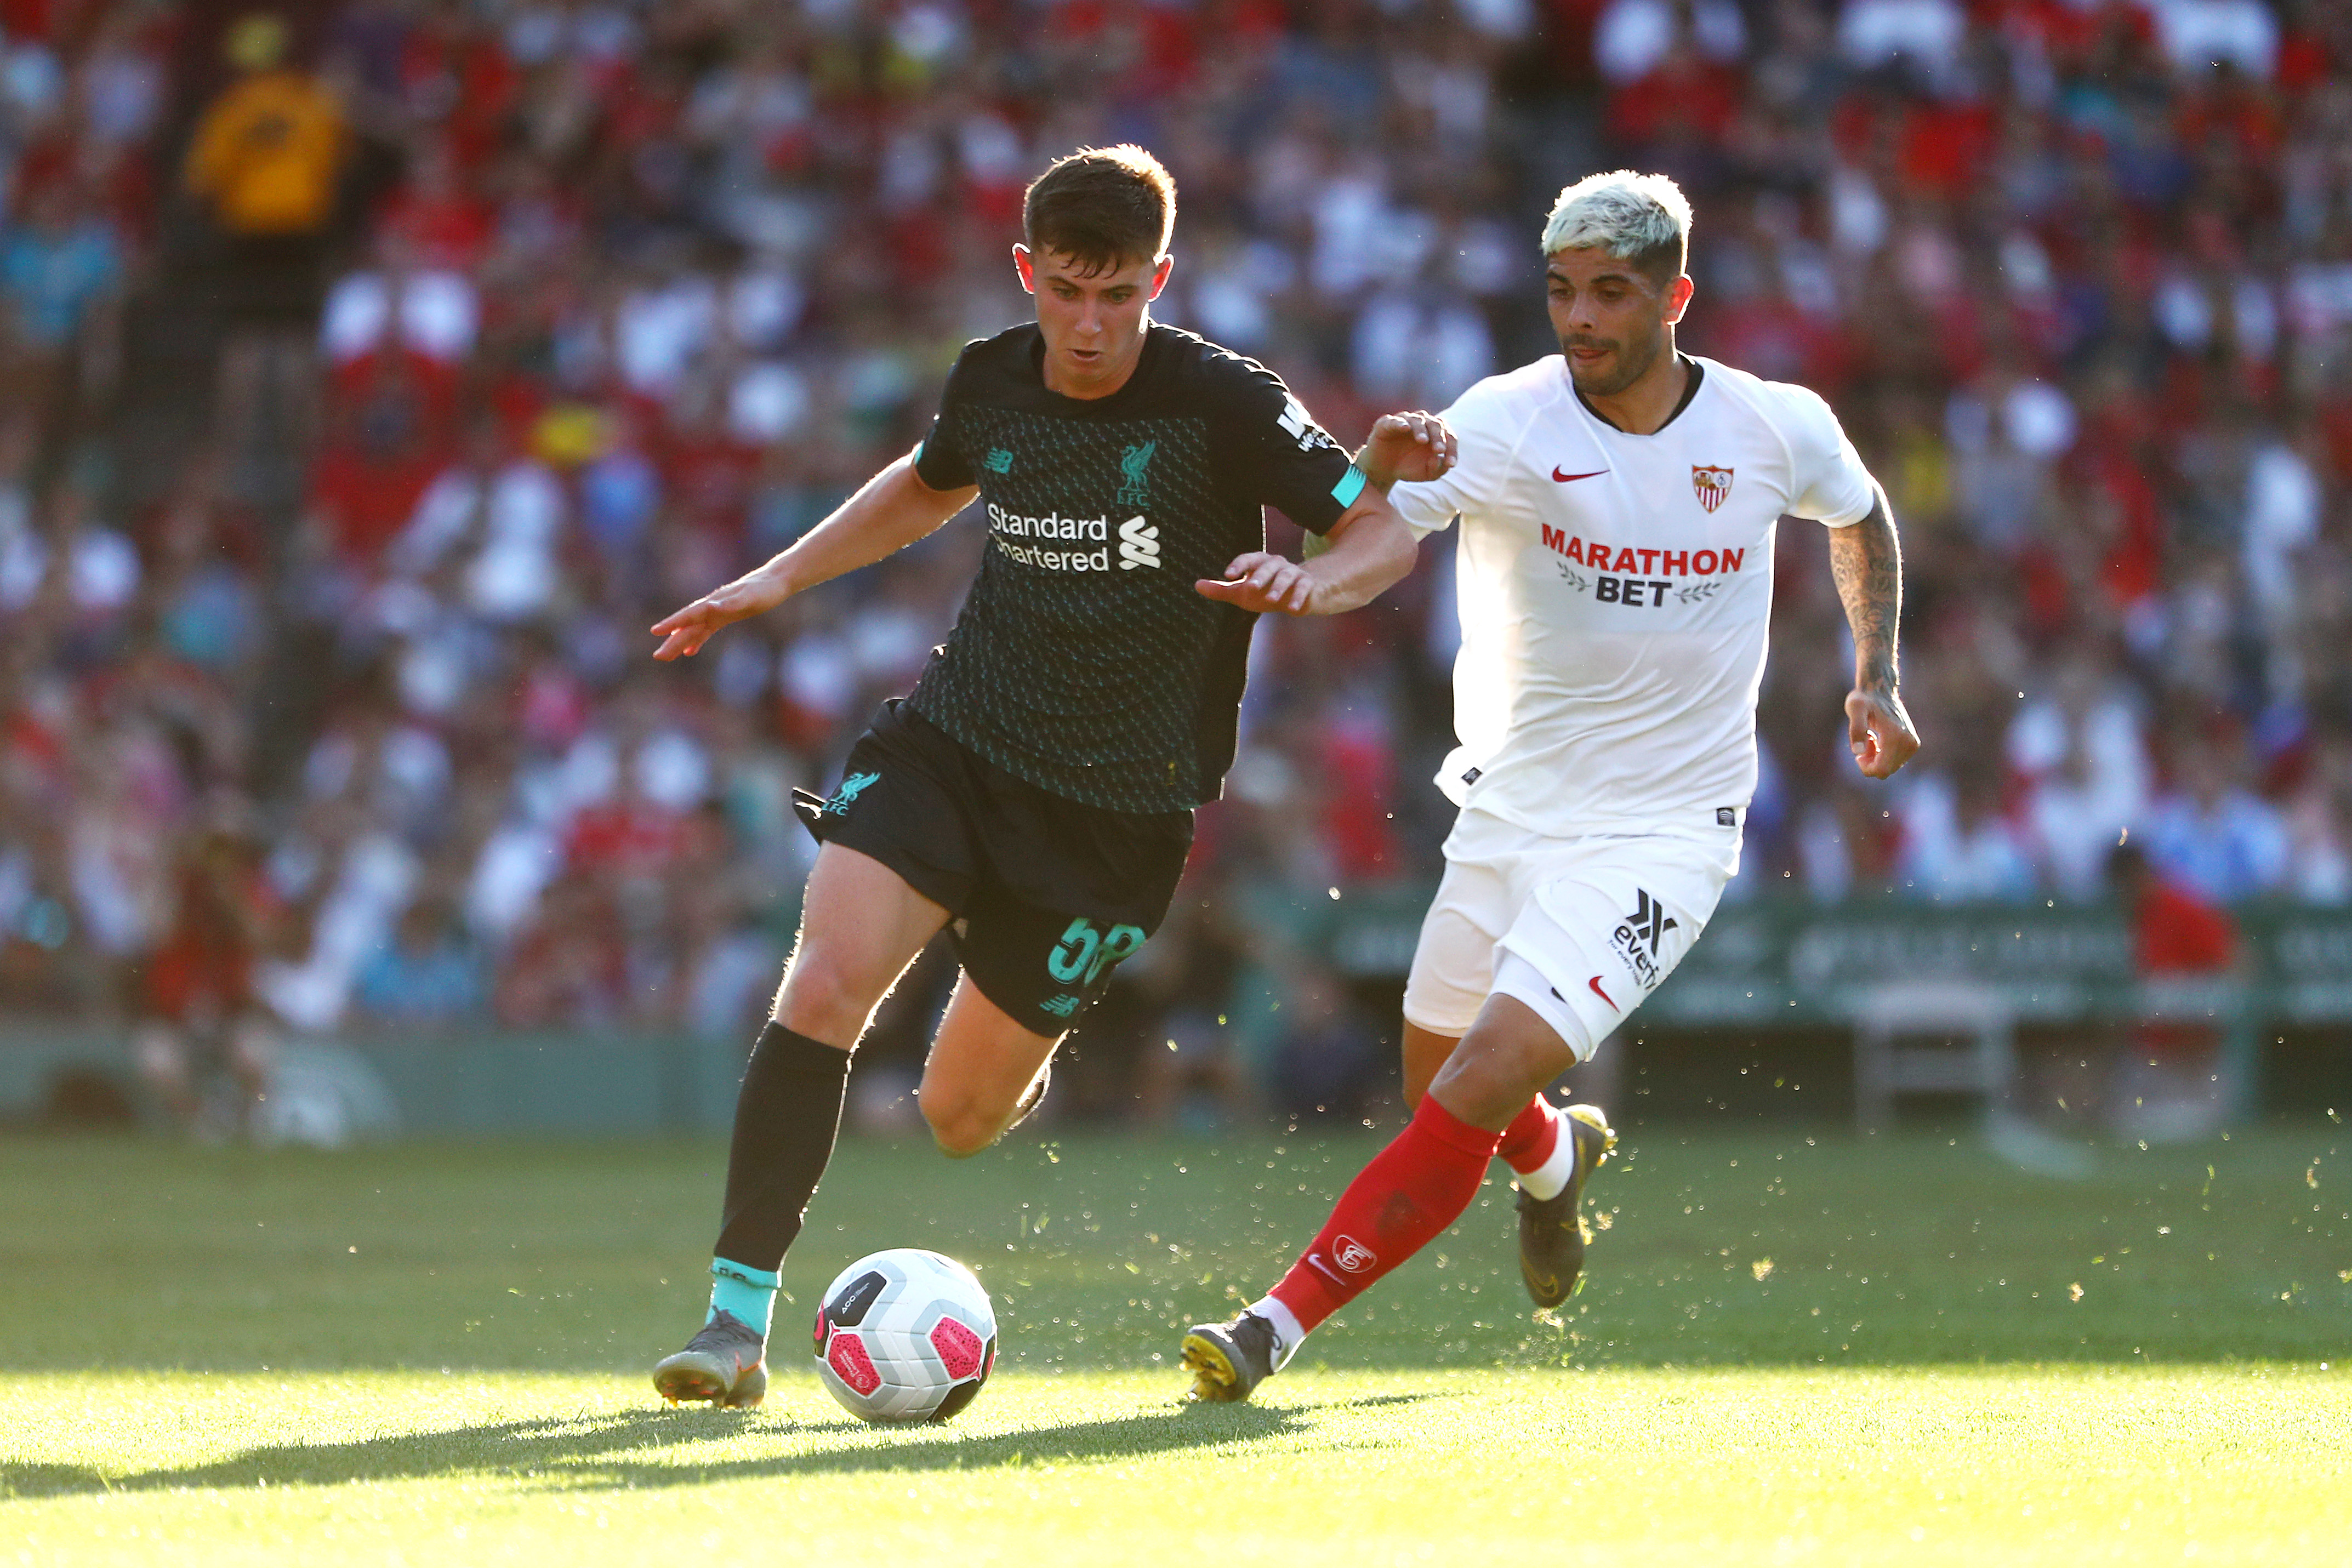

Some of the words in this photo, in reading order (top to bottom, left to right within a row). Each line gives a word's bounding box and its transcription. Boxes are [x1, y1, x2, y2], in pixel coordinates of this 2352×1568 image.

[987, 503, 1108, 541] Standard
[1541, 522, 1745, 576] MARATHON
[1596, 576, 1672, 607] BET
